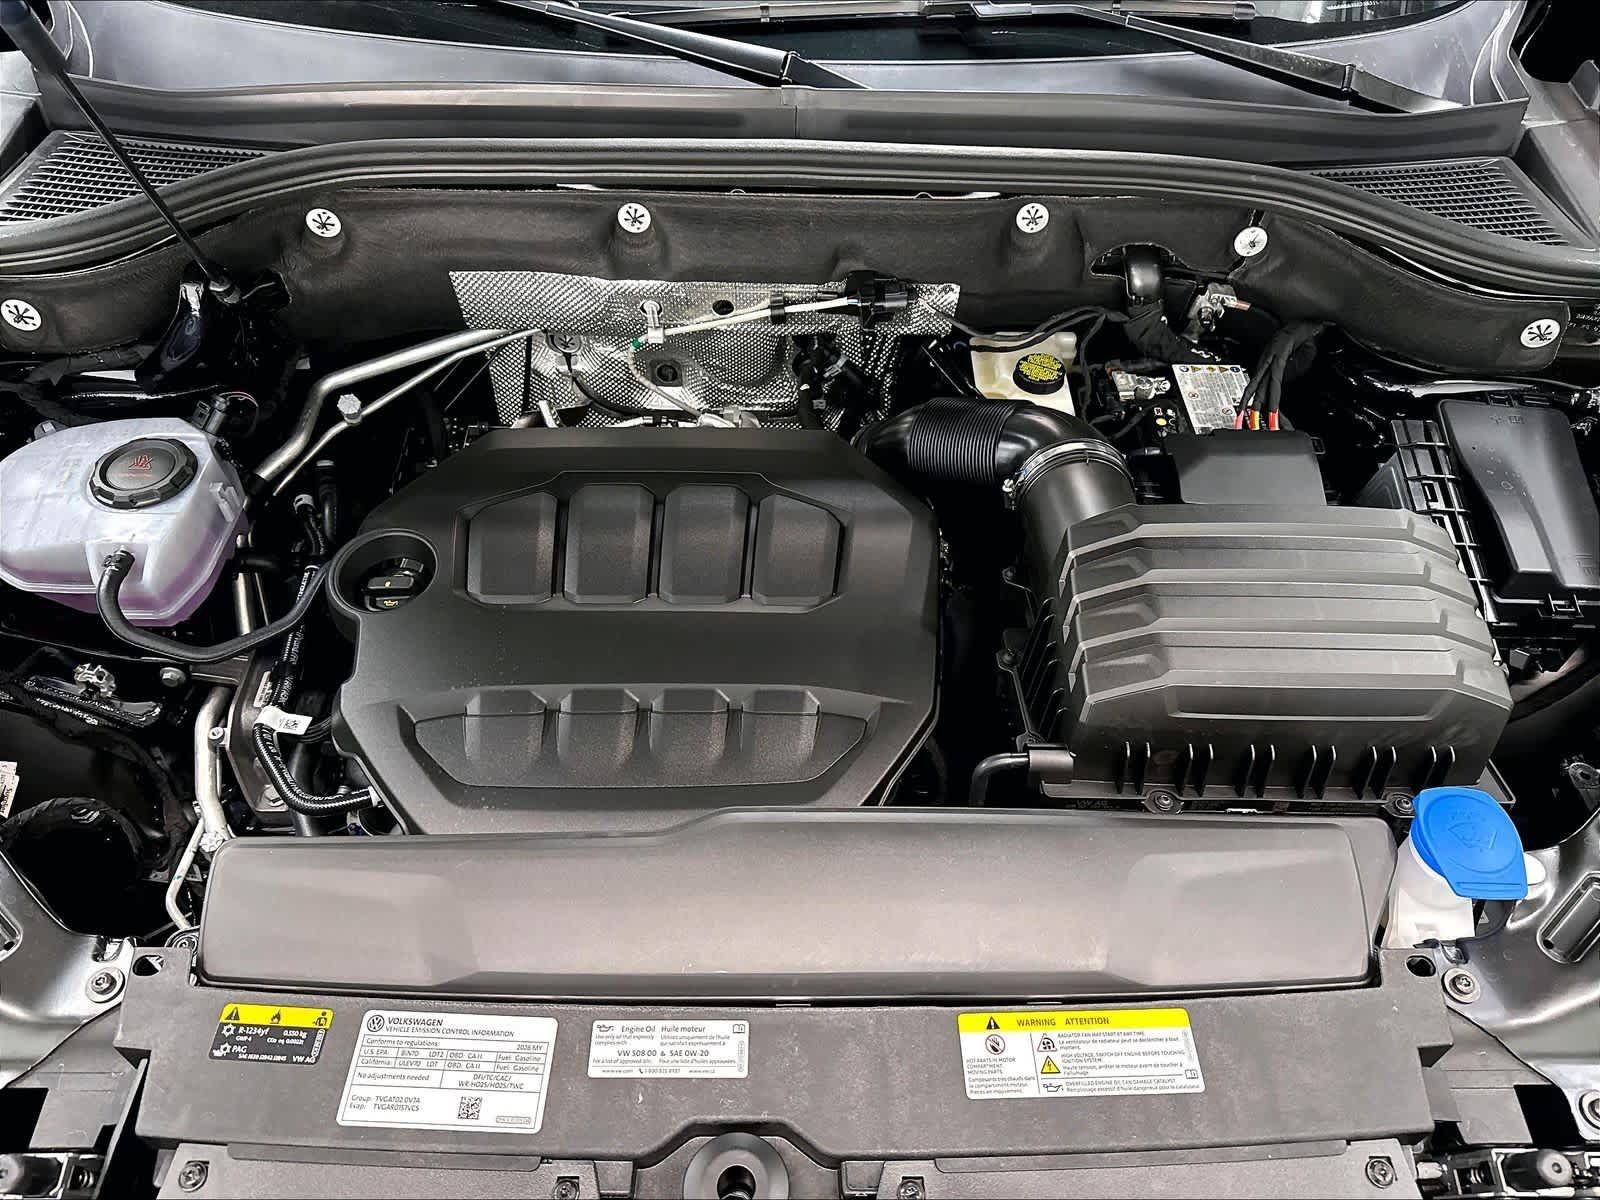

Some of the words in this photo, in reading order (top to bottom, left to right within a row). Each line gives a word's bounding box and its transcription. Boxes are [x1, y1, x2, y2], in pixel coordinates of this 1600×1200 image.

[387, 1017, 444, 1027] VOLKSWAGEN
[1016, 1018, 1056, 1027] WARNING
[1065, 1016, 1110, 1026] ATTENTION
[238, 1026, 270, 1037] R-1234yf
[385, 1025, 410, 1033] VEHICLE
[411, 1026, 441, 1034] EMISSION
[441, 1028, 470, 1036] CONTROL
[471, 1029, 515, 1038] INFORMATION
[621, 1025, 645, 1034] Engine
[645, 1024, 656, 1033] Oil
[661, 1024, 680, 1033] Huile
[680, 1025, 706, 1033] moteur
[231, 1045, 248, 1054] PAG
[617, 1049, 631, 1057] VW
[631, 1049, 646, 1057] 508
[646, 1049, 657, 1057] 00
[515, 1054, 542, 1062] Gasoline
[513, 1064, 540, 1073] Gasoline
[367, 1072, 406, 1081] adjustments
